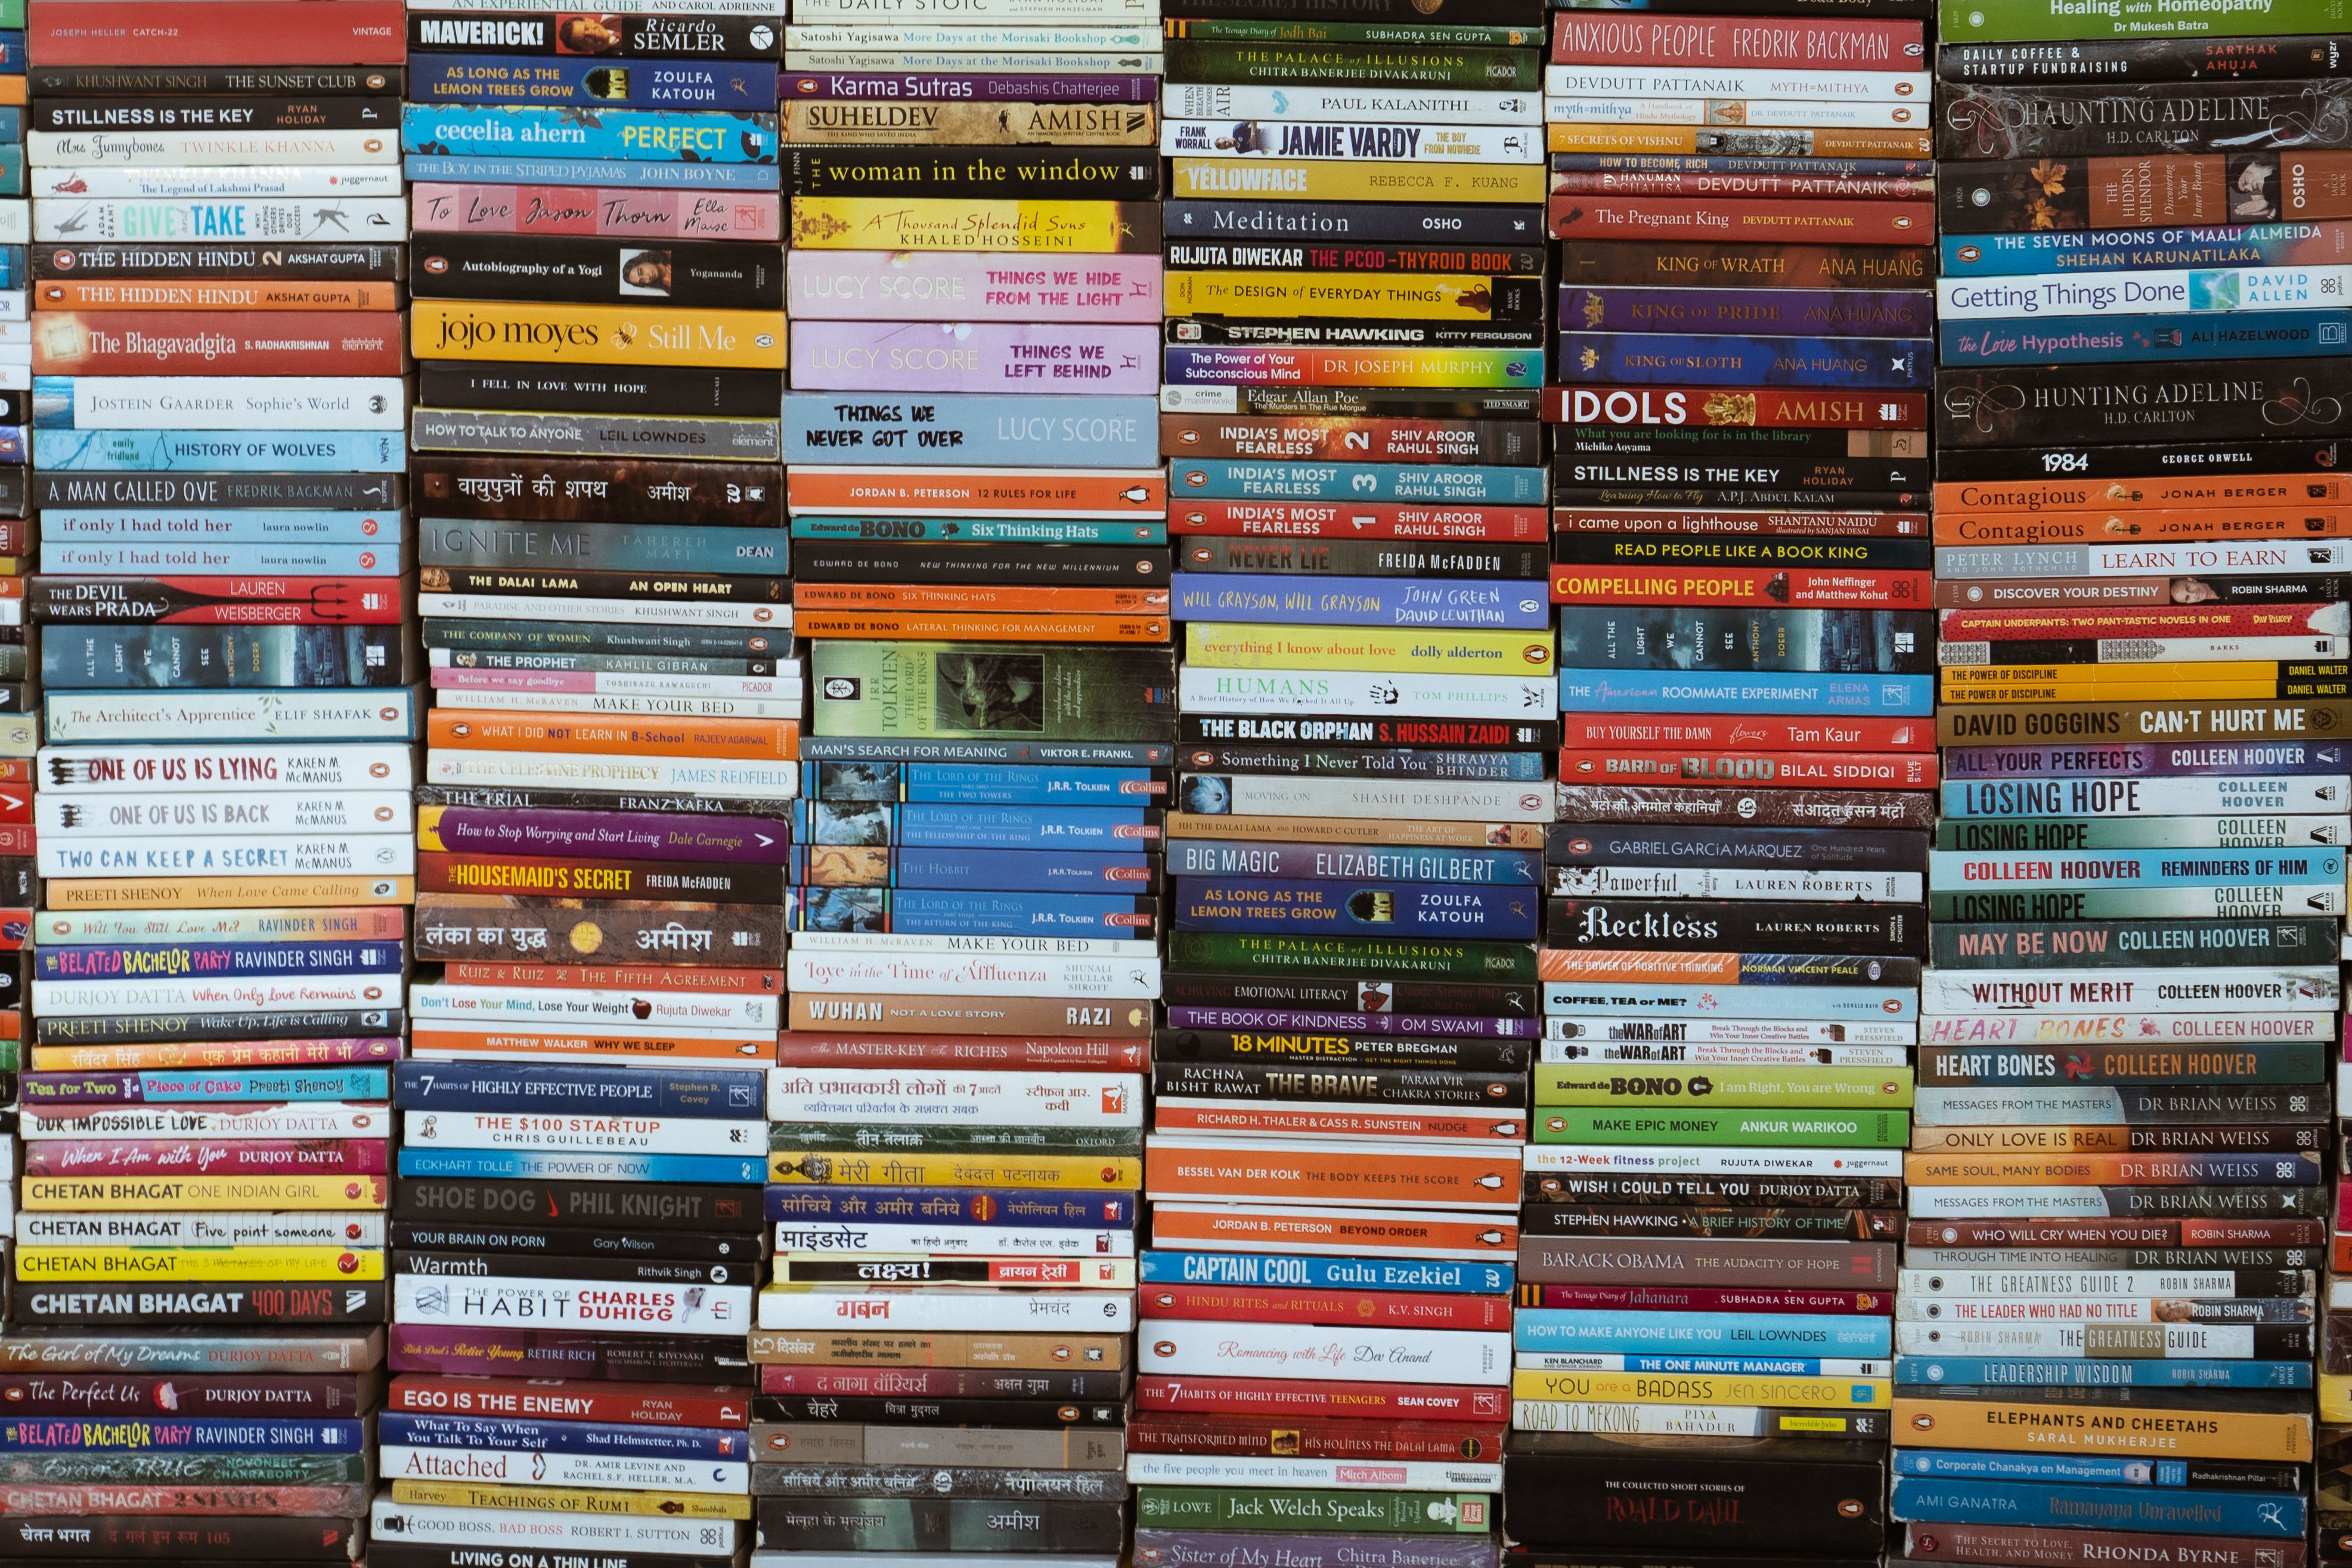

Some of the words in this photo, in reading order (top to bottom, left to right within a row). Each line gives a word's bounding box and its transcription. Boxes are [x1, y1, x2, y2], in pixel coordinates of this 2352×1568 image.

[51, 29, 87, 37] JOSEPH
[91, 29, 126, 37] HELLER
[133, 28, 179, 37] CATCH-22
[352, 27, 392, 36] VINTAGE
[420, 20, 544, 45] MAVERICK!
[2114, 21, 2127, 32] Dr
[2129, 20, 2174, 32] Mukesh
[2177, 20, 2209, 31] Batra
[1563, 21, 1643, 54] ANXIOUS
[1651, 23, 1716, 58] PEOPLE
[1733, 27, 1799, 59] FREDRIK
[1806, 30, 1889, 61] BACKMAN
[831, 76, 899, 97] Karma
[906, 77, 973, 97] Sutras
[988, 80, 1050, 95] Debashis
[1053, 81, 1120, 97] Chatterjee
[1750, 109, 1764, 117] DR
[1767, 109, 1808, 118] DEVDUTT
[1810, 110, 1856, 119] PATTANAIK
[435, 119, 515, 142] cecelia
[520, 122, 586, 143] ahern
[624, 125, 727, 150] PERFECT
[340, 175, 388, 186] juggernaut
[1187, 166, 1308, 192] YELLOWFACE
[1369, 175, 1434, 188] REBECCA
[1444, 177, 1460, 188] F.
[1472, 176, 1519, 189] KUANG
[2293, 163, 2305, 207] OSHO
[140, 184, 158, 194] The
[160, 184, 195, 194] Legend
[197, 184, 208, 193] of
[210, 183, 252, 193] Lakshmi
[253, 182, 285, 193] Prasad
[1422, 217, 1463, 231] OSHO
[900, 234, 975, 246] KHALED
[982, 234, 1073, 247] HOSSEINI
[690, 268, 743, 280] Yogananda
[1951, 286, 2038, 313] Getting
[2042, 283, 2117, 309] Things
[2124, 281, 2186, 302] Done
[471, 379, 475, 388] I
[482, 379, 510, 389] FELL
[516, 379, 530, 389] IN
[537, 381, 568, 392] LOVE
[574, 382, 607, 393] WITH
[614, 383, 647, 394] HOPE
[1485, 400, 1500, 408] TED
[1501, 400, 1529, 409] SMART
[1561, 390, 1687, 424] IDOLS
[112, 439, 135, 449] emily
[175, 443, 240, 457] HISTORY
[246, 444, 268, 457] OF
[272, 443, 336, 457] WOLVES
[1575, 441, 1613, 452] Michiko
[1614, 442, 1651, 454] Aoyama
[107, 450, 140, 461] fridlund
[2041, 453, 2089, 472] 1984
[2162, 454, 2204, 464] GEORGE
[2208, 453, 2253, 463] ORWELL
[850, 487, 896, 498] JORDAN
[899, 488, 910, 498] B.
[914, 488, 970, 499] PETERSON
[2102, 551, 2176, 570] LEARN
[2186, 551, 2217, 567] TO
[2226, 550, 2287, 566] EARN
[230, 581, 286, 596] LAUREN
[215, 606, 301, 621] WEISBERGER
[1411, 646, 1444, 661] dolly
[1446, 646, 1503, 659] alderton
[742, 681, 773, 693] PICADOR
[881, 649, 898, 732] TOLKIEN
[1412, 691, 1443, 701] TOM
[1447, 692, 1509, 703] PHILLIPS
[275, 709, 308, 722] ELIF
[313, 708, 372, 720] SHAFAK
[1040, 748, 1077, 758] VIKTOR
[1080, 749, 1090, 758] E.
[1092, 749, 1134, 759] FRANKL
[1186, 848, 1214, 871] BIG
[1222, 850, 1280, 873] MAGIC
[1316, 853, 1414, 878] ELIZABETH
[1418, 857, 1495, 881] GILBERT
[646, 874, 680, 887] FREIDA
[681, 876, 731, 890] McFADDEN
[66, 888, 118, 902] PREETI
[120, 887, 182, 901] SHENOY
[1578, 906, 1718, 943] Reckless
[426, 923, 472, 946] लंका
[477, 926, 504, 945] का
[511, 927, 548, 951] युद्ध
[636, 922, 712, 952] अमीश
[1065, 964, 1112, 974] SHUNALI
[1063, 973, 1113, 983] KHULLAR
[1068, 982, 1108, 991] SHROFF
[1972, 983, 2064, 1005] WITHOUT
[2071, 983, 2134, 1003] MERIT
[2157, 985, 2220, 1000] COLLEEN
[2225, 984, 2282, 1000] HOOVER
[808, 1000, 883, 1021] WUHAN
[1066, 1007, 1111, 1025] RAZI
[1025, 1042, 1083, 1058] Napoleon
[1086, 1043, 1109, 1056] Hill
[1942, 1099, 1999, 1111] MESSAGES
[2002, 1100, 2034, 1111] FROM
[2035, 1099, 2059, 1111] THE
[2062, 1099, 2112, 1110] MASTERS
[474, 1116, 513, 1130] THE
[519, 1117, 563, 1132] $100
[570, 1119, 661, 1133] STARTUP
[1427, 1122, 1468, 1133] NUDGE
[1592, 1119, 1632, 1131] MAKE
[1634, 1120, 1666, 1132] EPIC
[1669, 1120, 1719, 1132] MONEY
[1740, 1120, 1789, 1133] ANKUR
[1791, 1121, 1858, 1134] WARIKOO
[492, 1133, 541, 1144] CHRIS
[547, 1135, 649, 1146] GUILLEBEAU
[838, 1158, 870, 1182] मेरी
[881, 1159, 925, 1184] गीता
[1845, 1158, 1889, 1169] juggernaut
[953, 1164, 994, 1182] देवदत्त
[1002, 1167, 1060, 1183] पटनायक
[32, 1183, 104, 1199] CHETAN
[110, 1183, 184, 1199] BHAGAT
[188, 1185, 222, 1198] ONE
[226, 1185, 281, 1198] INDIAN
[286, 1184, 320, 1198] GIRL
[1340, 1225, 1385, 1236] BEYOND
[1388, 1226, 1428, 1237] ORDER
[410, 1256, 488, 1275] Warmth
[836, 1299, 890, 1319] गबन
[1028, 1299, 1071, 1316] प्रेमचंद
[1731, 1329, 1755, 1341] LEIL
[1759, 1330, 1827, 1342] LOWNDES
[1987, 1411, 2086, 1428] ELEPHANTS
[2091, 1415, 2125, 1430] AND
[2131, 1417, 2219, 1434] CHEETAHS
[405, 1451, 507, 1478] Attached
[1340, 1469, 1367, 1480] Mitch
[1369, 1470, 1403, 1482] Albom
[691, 1504, 727, 1514] Shambhala
[1173, 1501, 1213, 1514] LOWE
[1227, 1497, 1265, 1520] Jack
[1269, 1498, 1322, 1518] Welch
[1327, 1499, 1386, 1521] Speaks
[19, 1523, 53, 1544] चेतन
[57, 1529, 91, 1544] भगत
[2083, 1544, 2171, 1563] RHONDA
[2177, 1547, 2239, 1565] BYRNE
